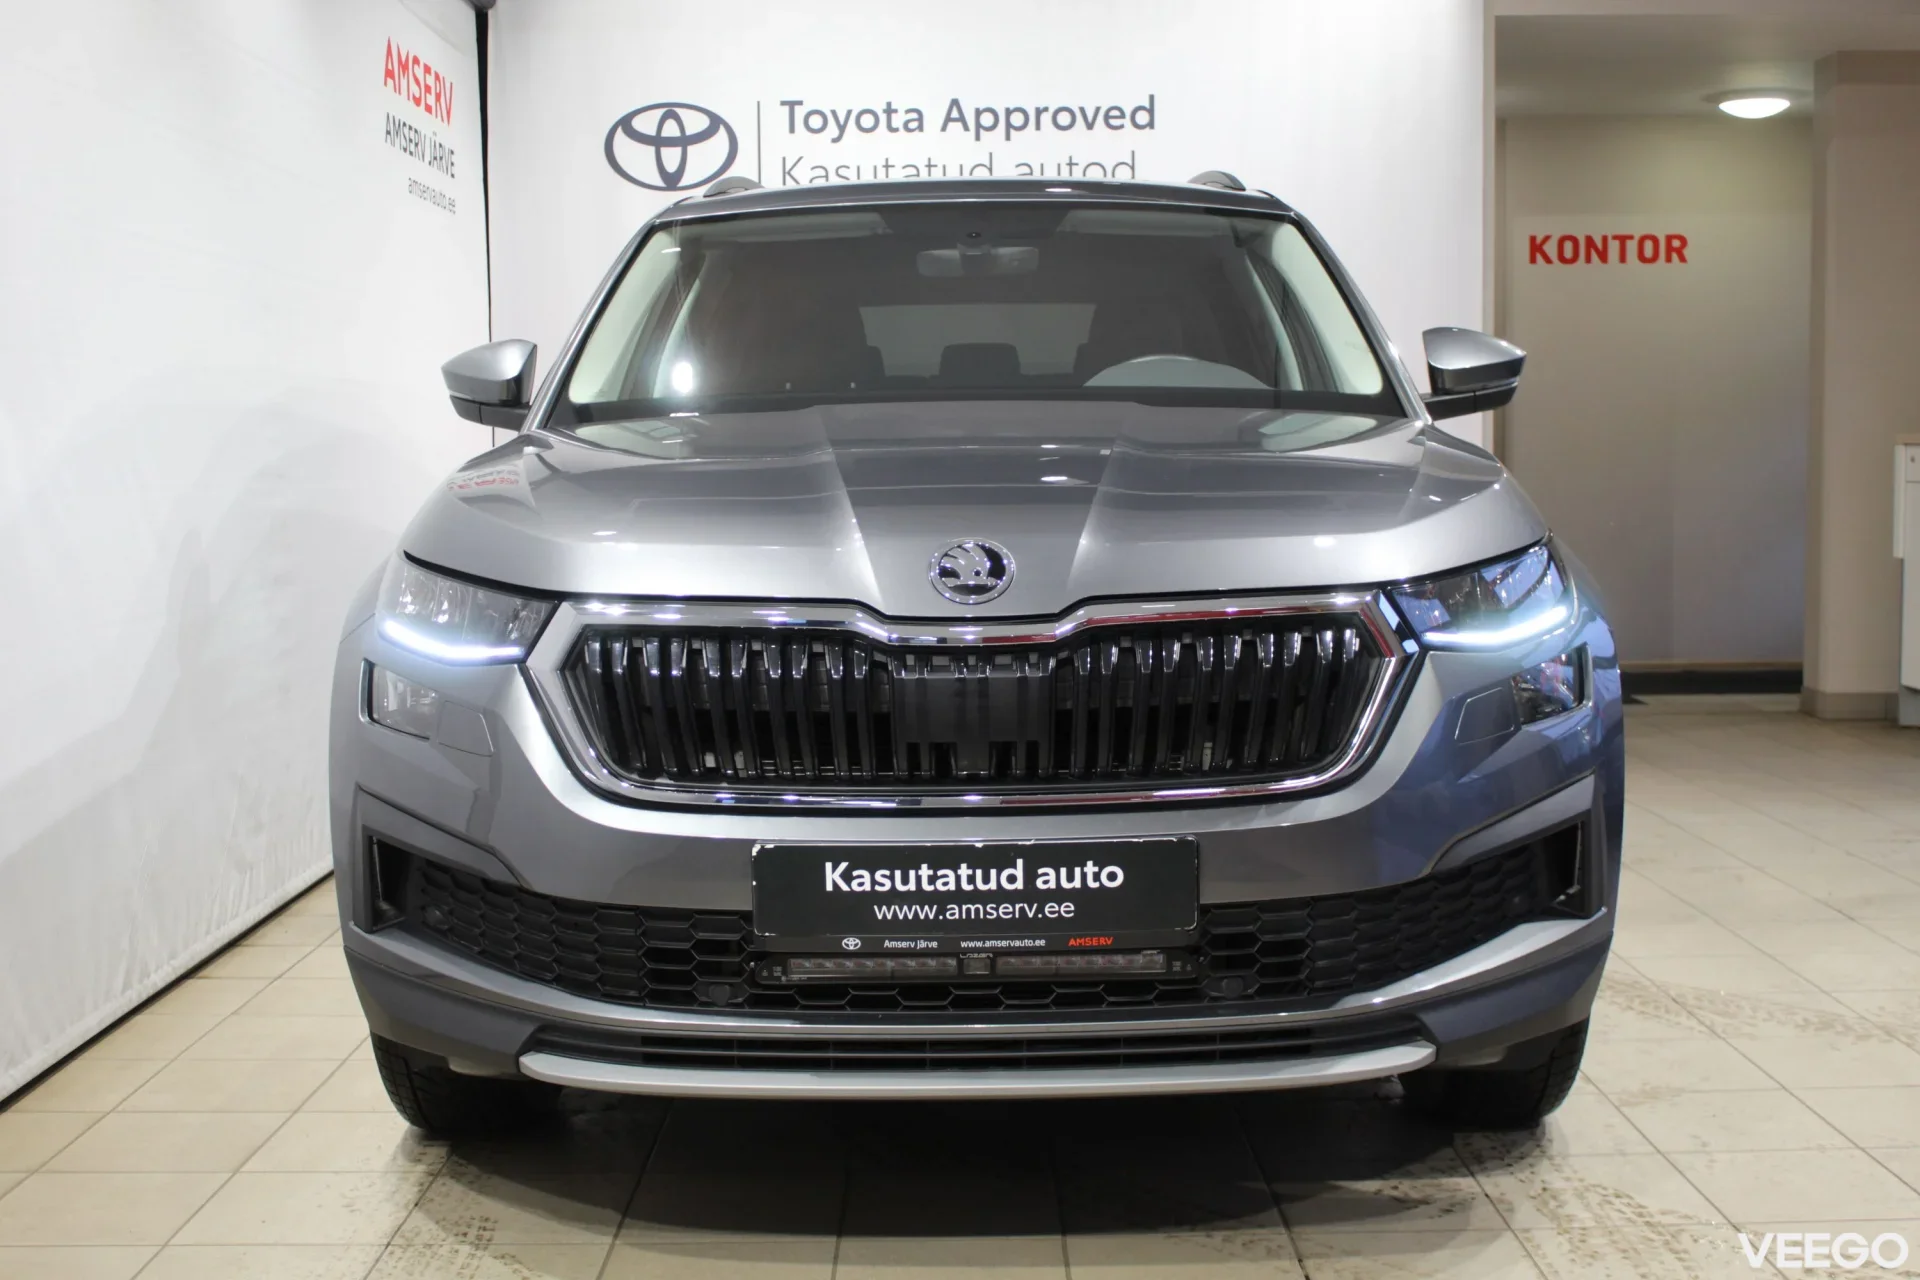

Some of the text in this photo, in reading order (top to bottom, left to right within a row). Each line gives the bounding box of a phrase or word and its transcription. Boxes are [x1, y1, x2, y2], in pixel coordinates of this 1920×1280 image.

[384, 36, 453, 127] AMSERV
[780, 94, 1156, 143] Toyota Approved
[385, 112, 455, 178] AMSERV JÄRVE
[408, 177, 456, 214] amservauto.ee
[1528, 233, 1689, 265] KONTOR
[825, 858, 1125, 892] Kasutatud auto
[874, 901, 1075, 920] www.amserv.ee
[884, 939, 915, 948] Amserv
[960, 938, 1046, 949] www.amservauto.ee
[1068, 936, 1114, 947] AMSERV
